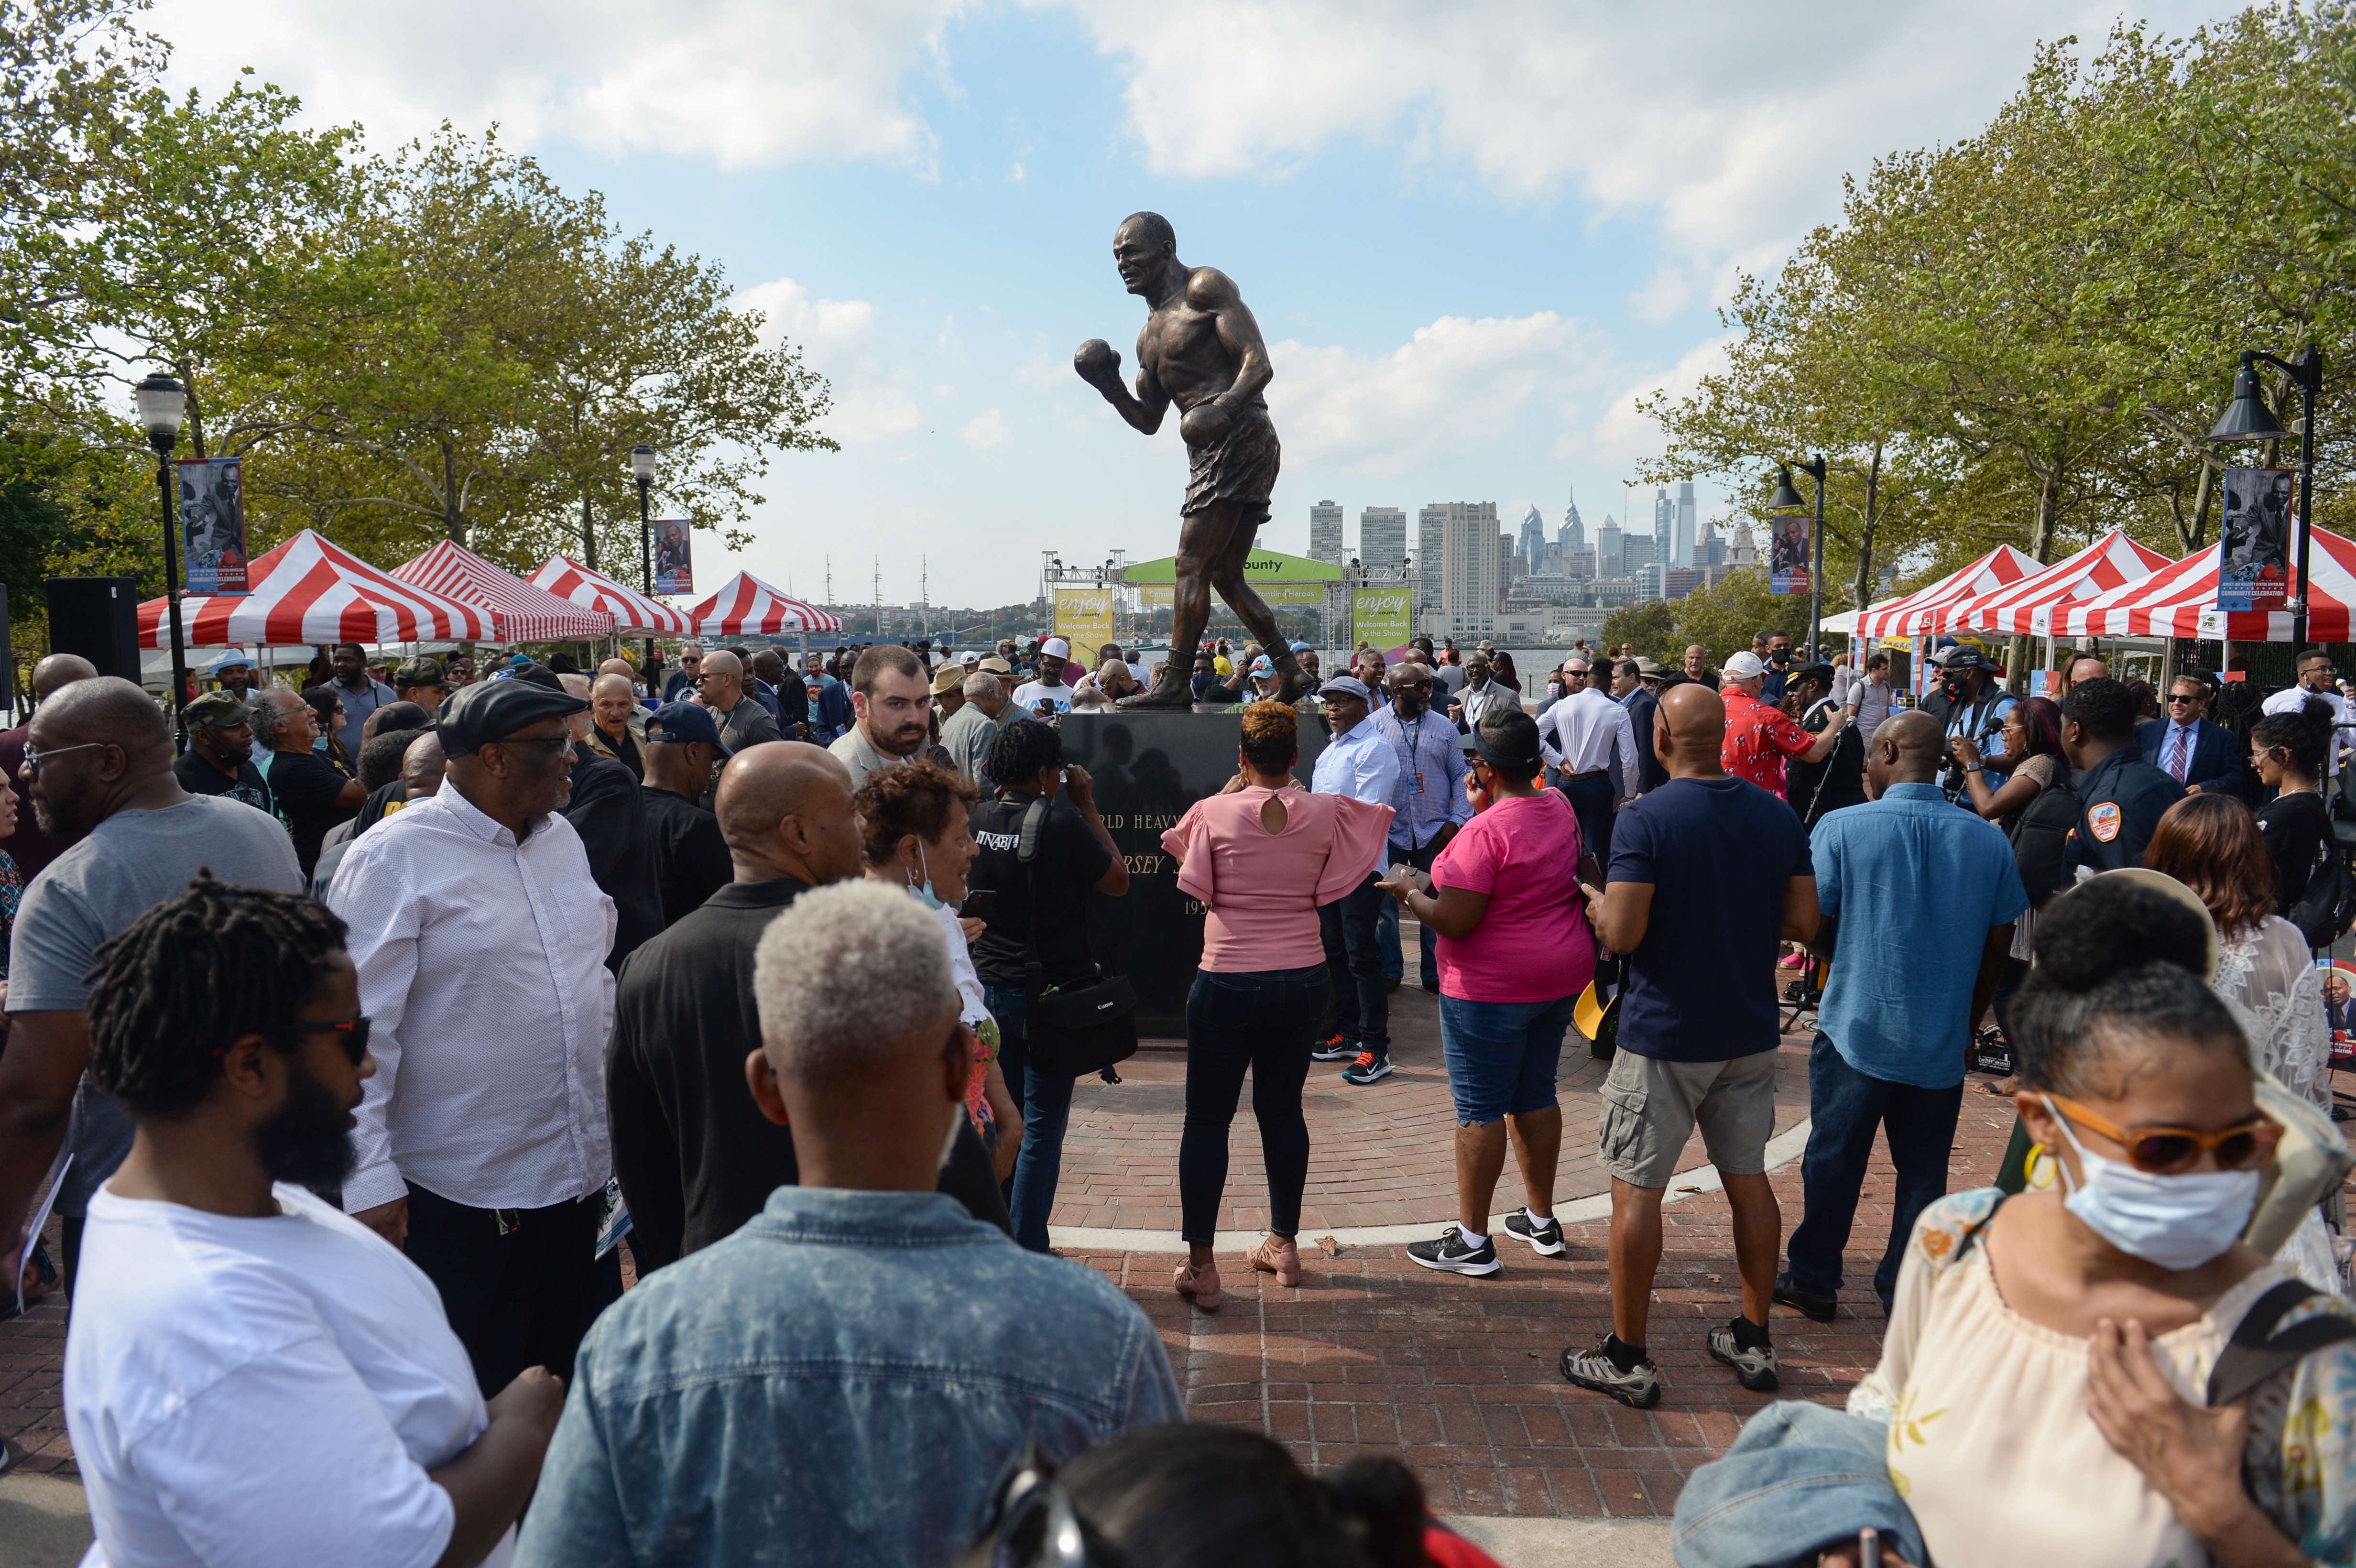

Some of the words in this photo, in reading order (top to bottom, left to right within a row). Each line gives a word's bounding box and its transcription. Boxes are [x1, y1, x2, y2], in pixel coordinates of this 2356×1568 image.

[1243, 560, 1283, 573] ounty
[1058, 592, 1110, 619] enjoy
[1356, 591, 1408, 617] enjoy
[1134, 815, 1182, 828] HEAVY
[982, 834, 1014, 851] NABJ
[1124, 855, 1166, 874] RSEY
[1097, 1002, 1113, 1010] Canon
[1980, 1056, 2009, 1066] whirwind
